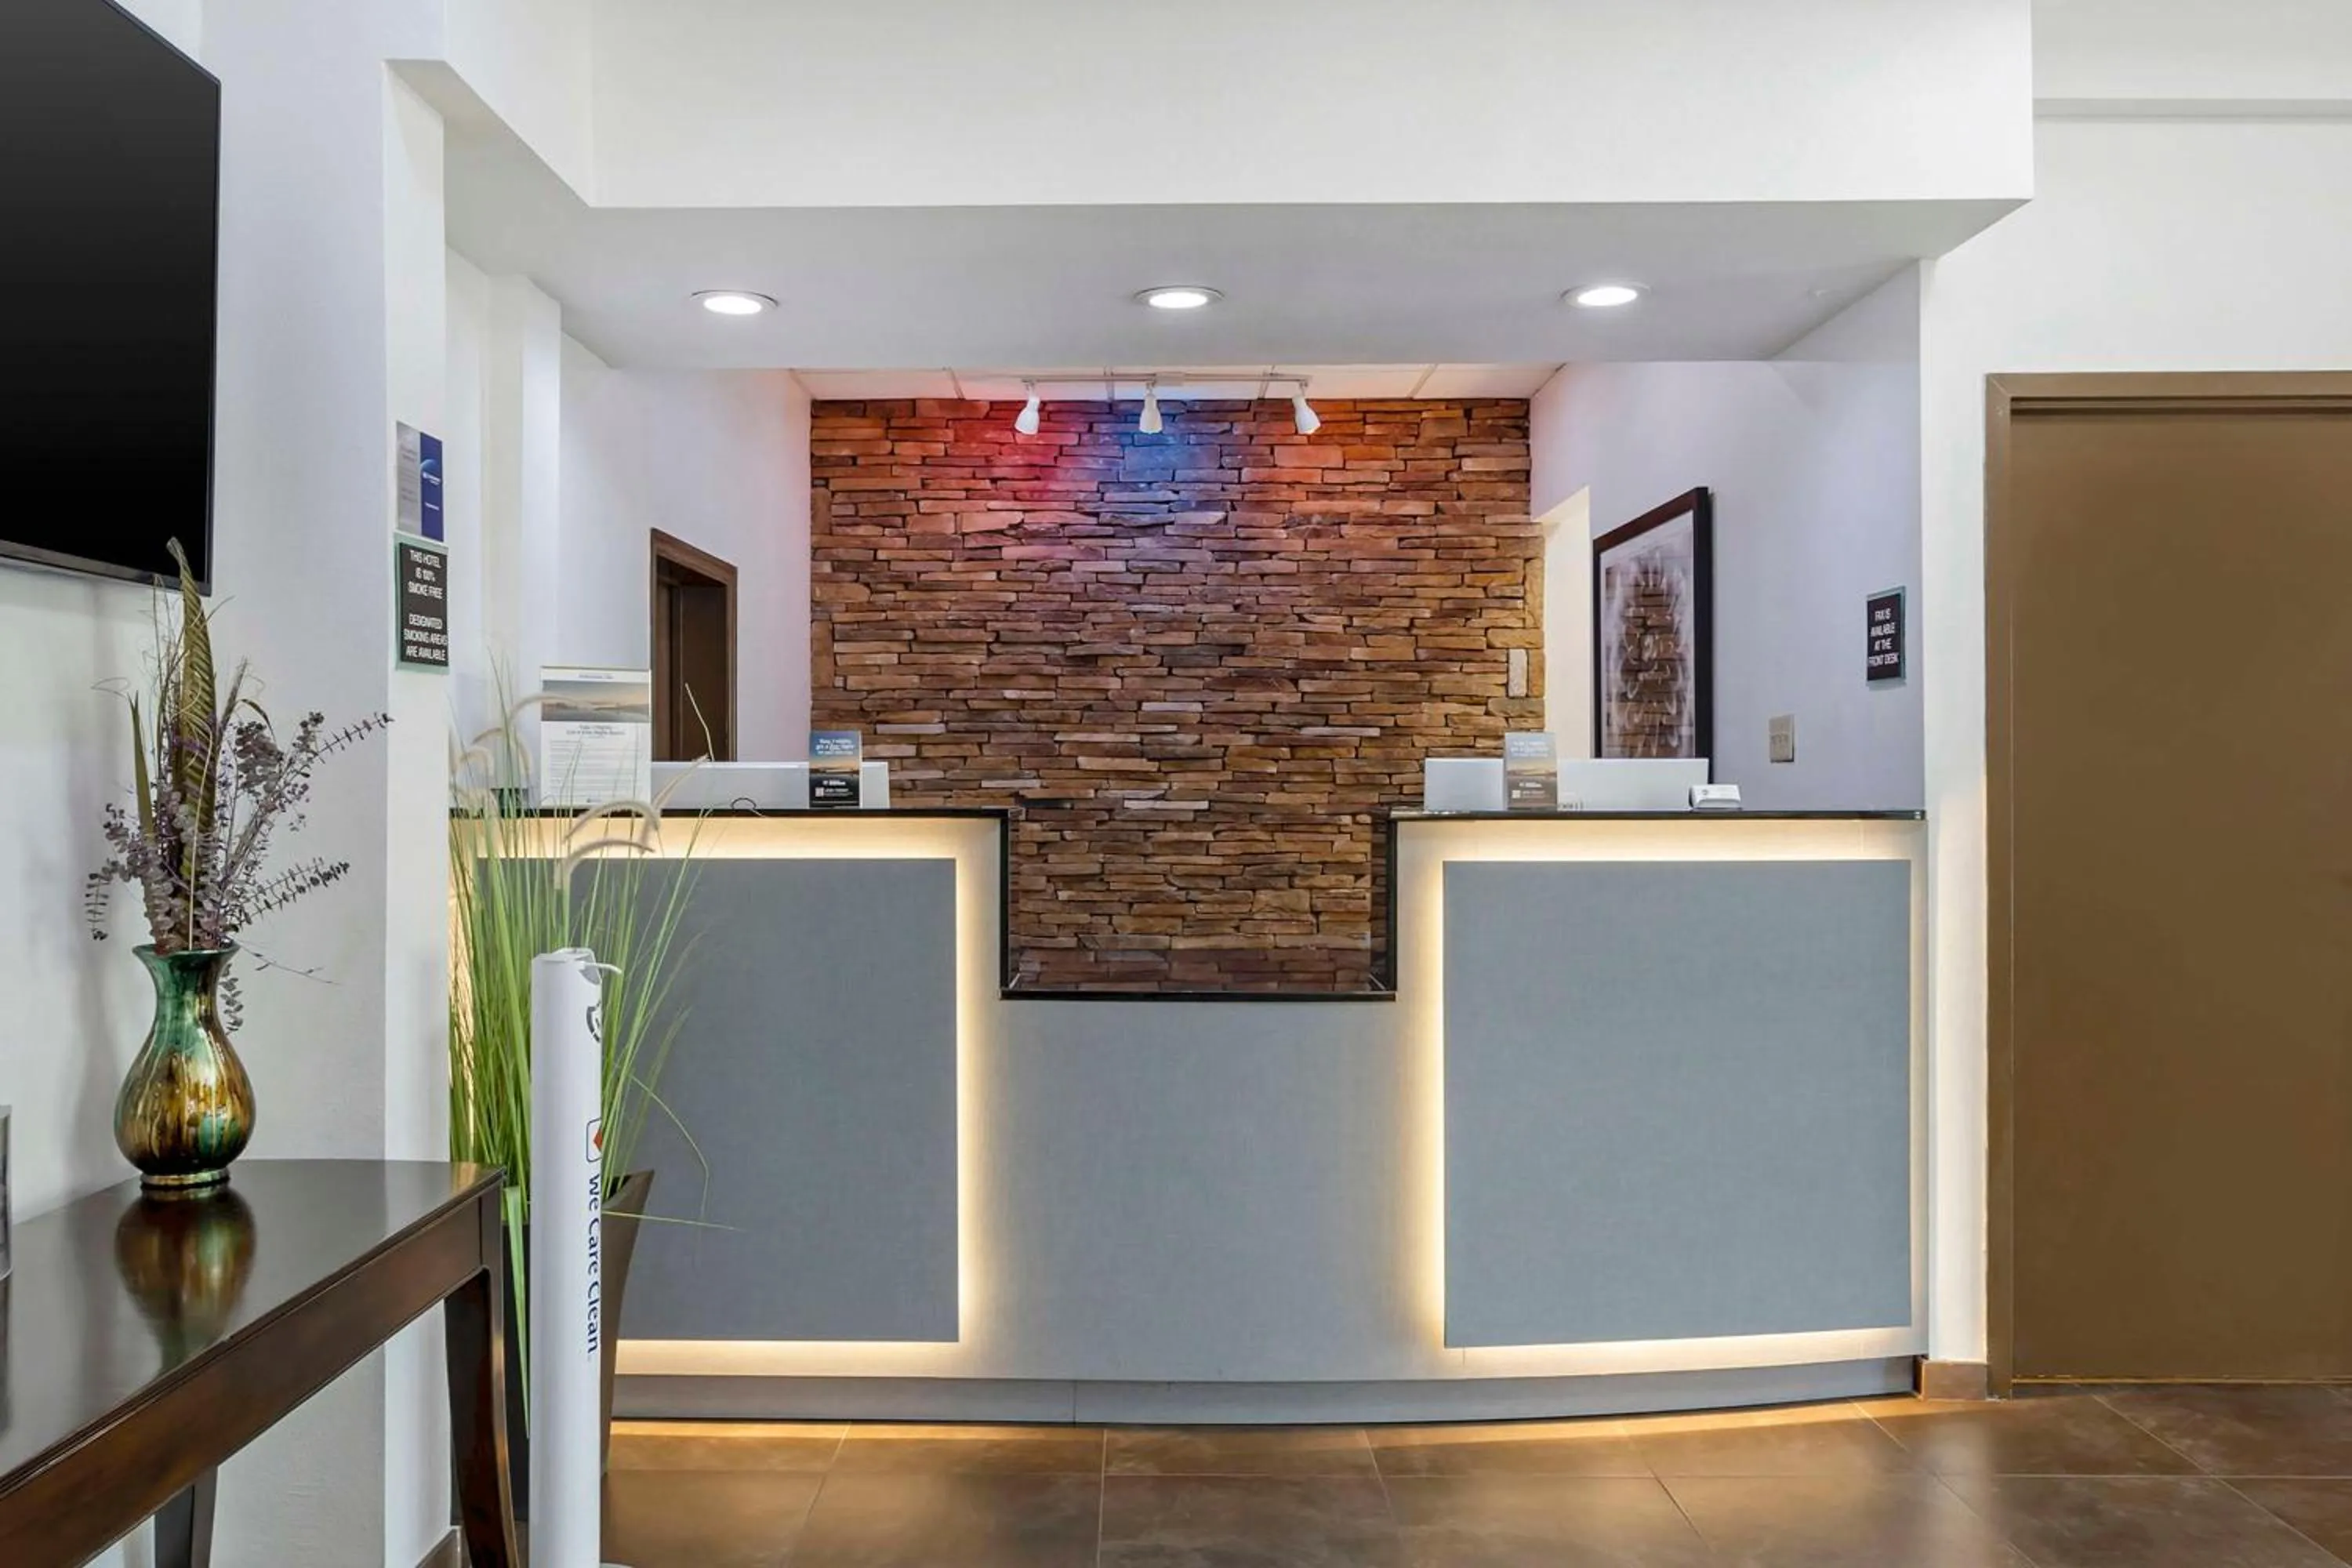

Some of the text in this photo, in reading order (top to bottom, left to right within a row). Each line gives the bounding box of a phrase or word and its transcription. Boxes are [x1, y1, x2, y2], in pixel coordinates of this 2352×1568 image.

[409, 549, 441, 568] THIS HOTEL
[408, 580, 443, 599] SMOKE FREE
[404, 628, 429, 643] SMOKING
[406, 645, 445, 661] ARE AVAILABLE
[1884, 652, 1899, 665] DESK
[588, 1218, 599, 1276] Care
[587, 1280, 599, 1353] Clean
